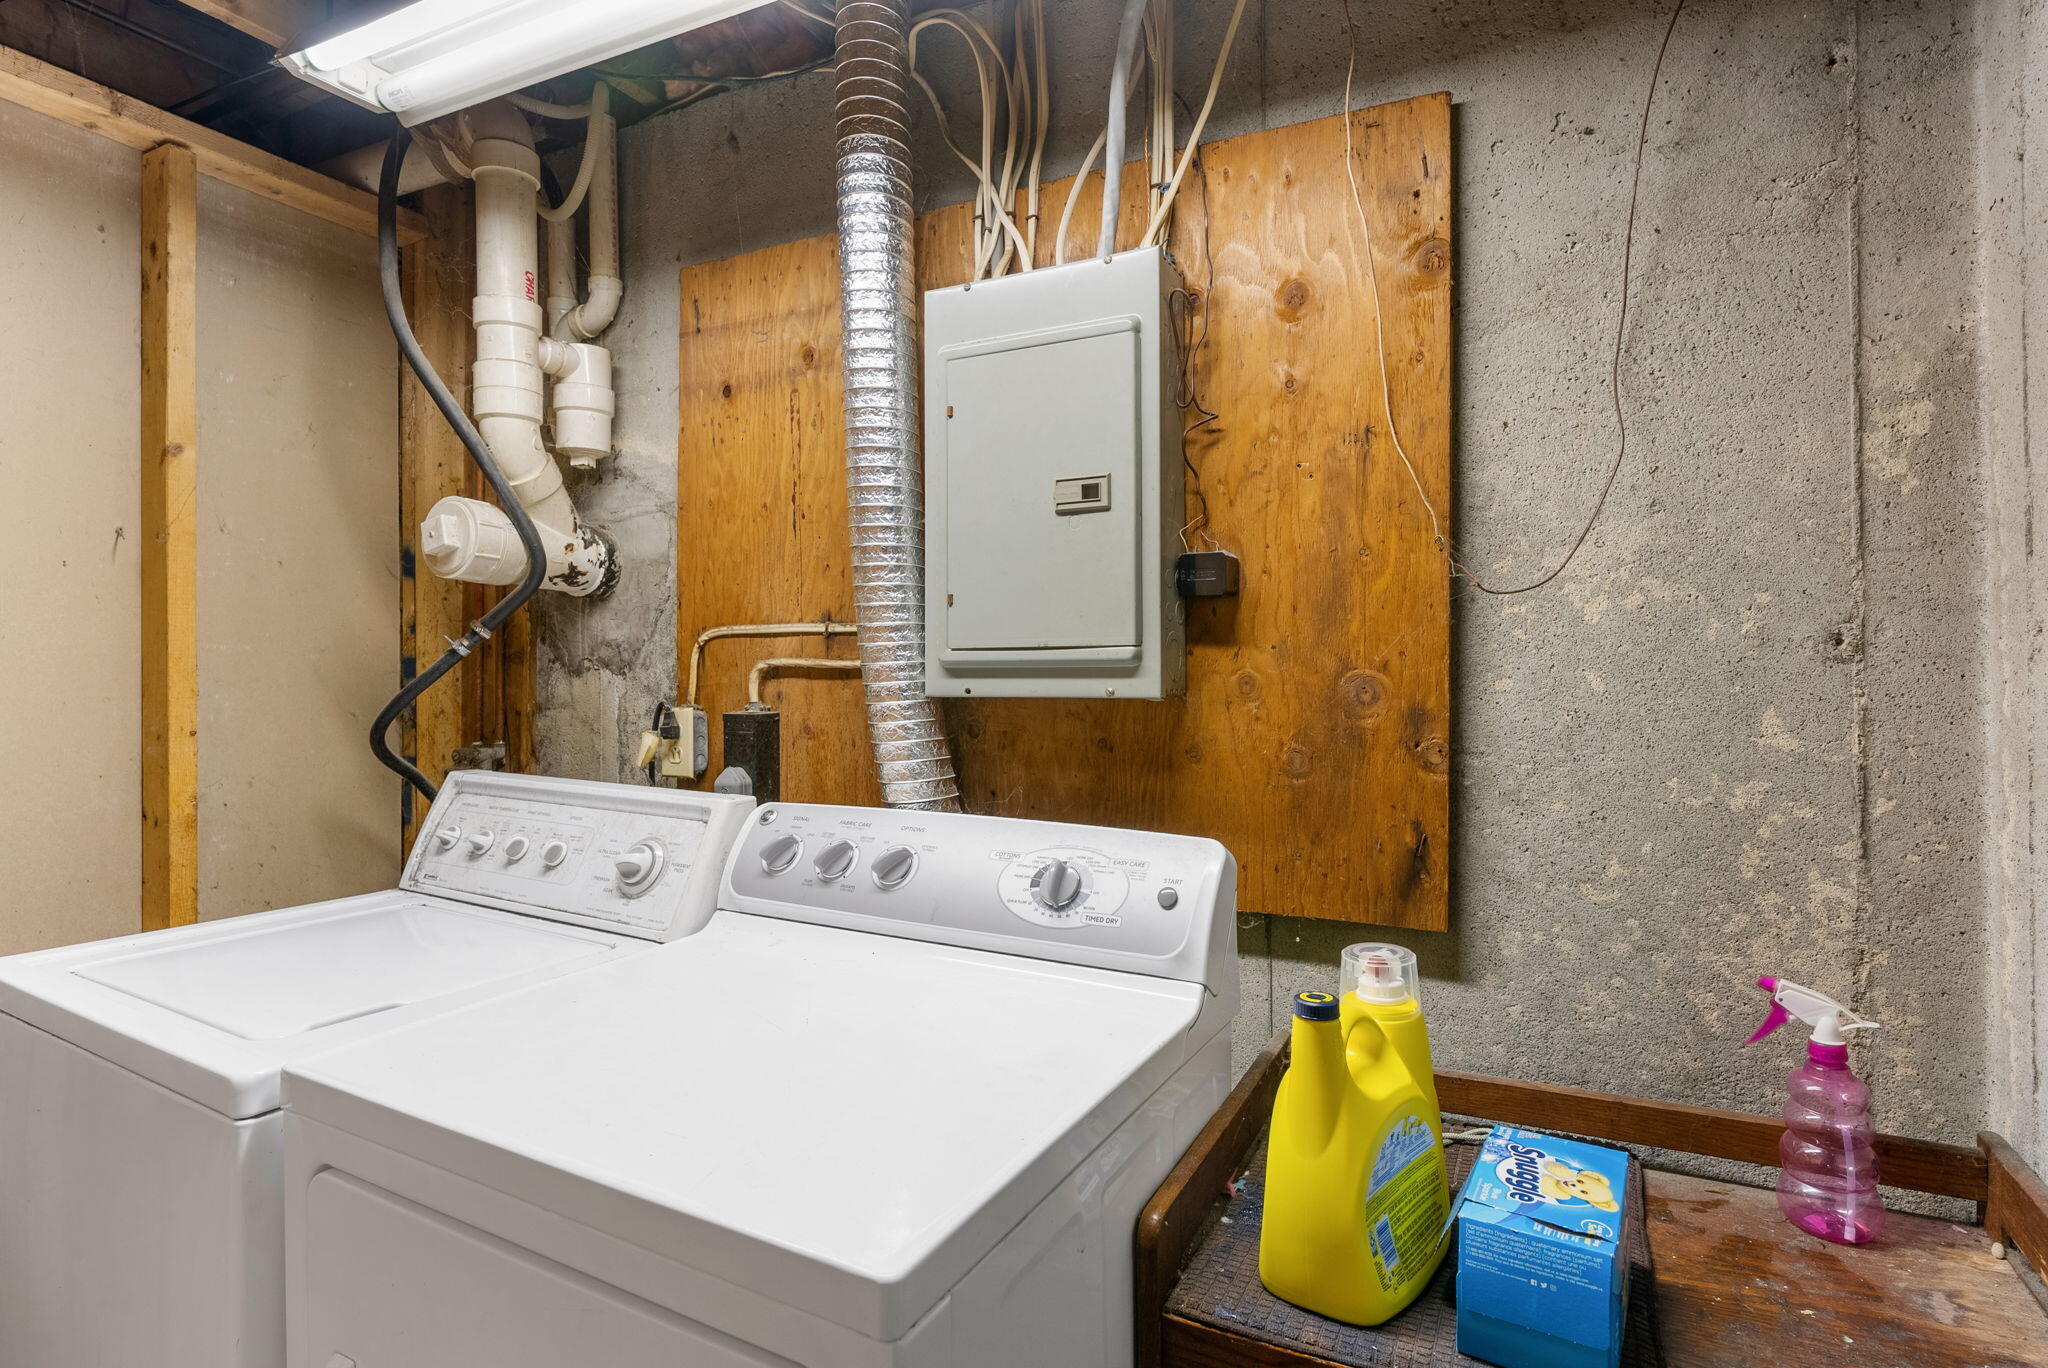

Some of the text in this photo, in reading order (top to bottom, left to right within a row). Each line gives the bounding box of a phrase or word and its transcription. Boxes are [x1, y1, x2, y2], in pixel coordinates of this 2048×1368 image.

[839, 819, 858, 827] FABRIC
[900, 825, 927, 833] OPTIONS
[995, 851, 1021, 859] COTTONS
[1113, 859, 1128, 867] EASY
[1163, 878, 1183, 886] START
[1084, 914, 1119, 925] TIMED DRY
[1505, 1143, 1547, 1204] Snuggle
